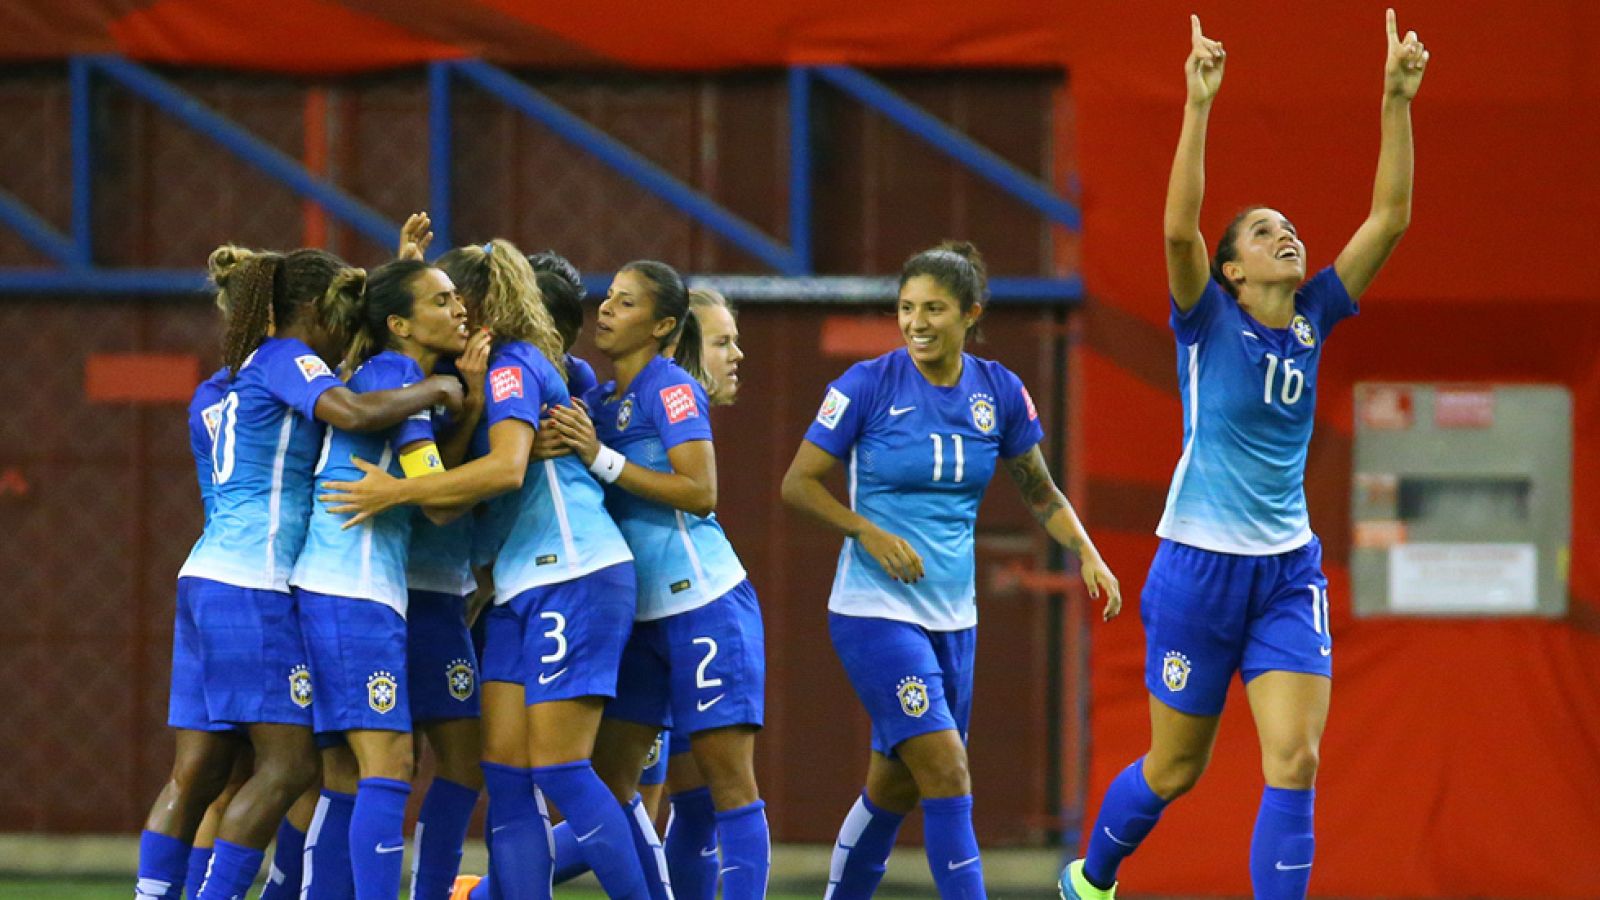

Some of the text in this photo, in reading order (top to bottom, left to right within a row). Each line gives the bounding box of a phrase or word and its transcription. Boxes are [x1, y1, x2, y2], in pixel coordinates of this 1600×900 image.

[1263, 352, 1304, 405] 16
[929, 433, 964, 483] 11
[539, 611, 568, 664] 3
[692, 636, 722, 689] 2
